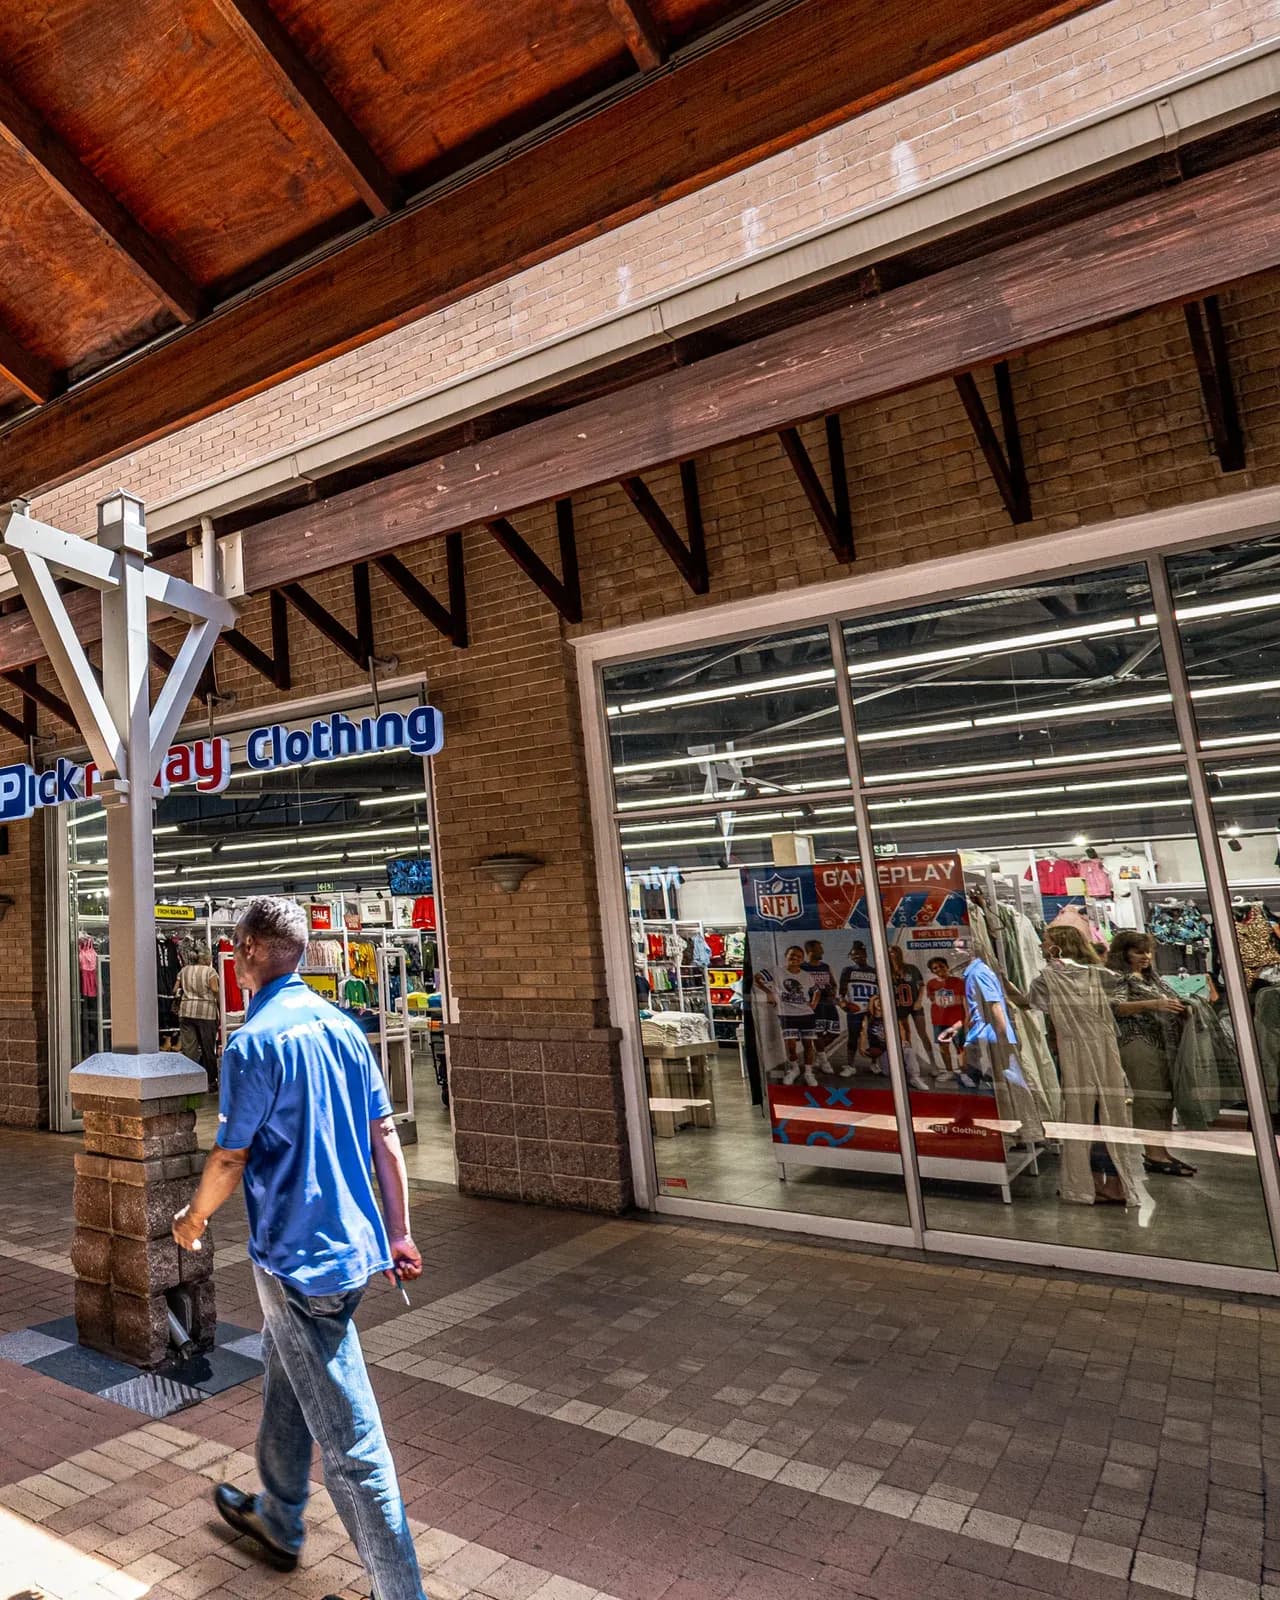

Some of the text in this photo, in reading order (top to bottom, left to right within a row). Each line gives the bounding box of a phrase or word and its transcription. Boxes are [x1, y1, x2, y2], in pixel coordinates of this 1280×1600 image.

[152, 737, 228, 793] ay
[247, 706, 440, 770] Clothing
[760, 895, 799, 917] NFL
[312, 910, 329, 919] SALE
[952, 1126, 987, 1137] Clothing
